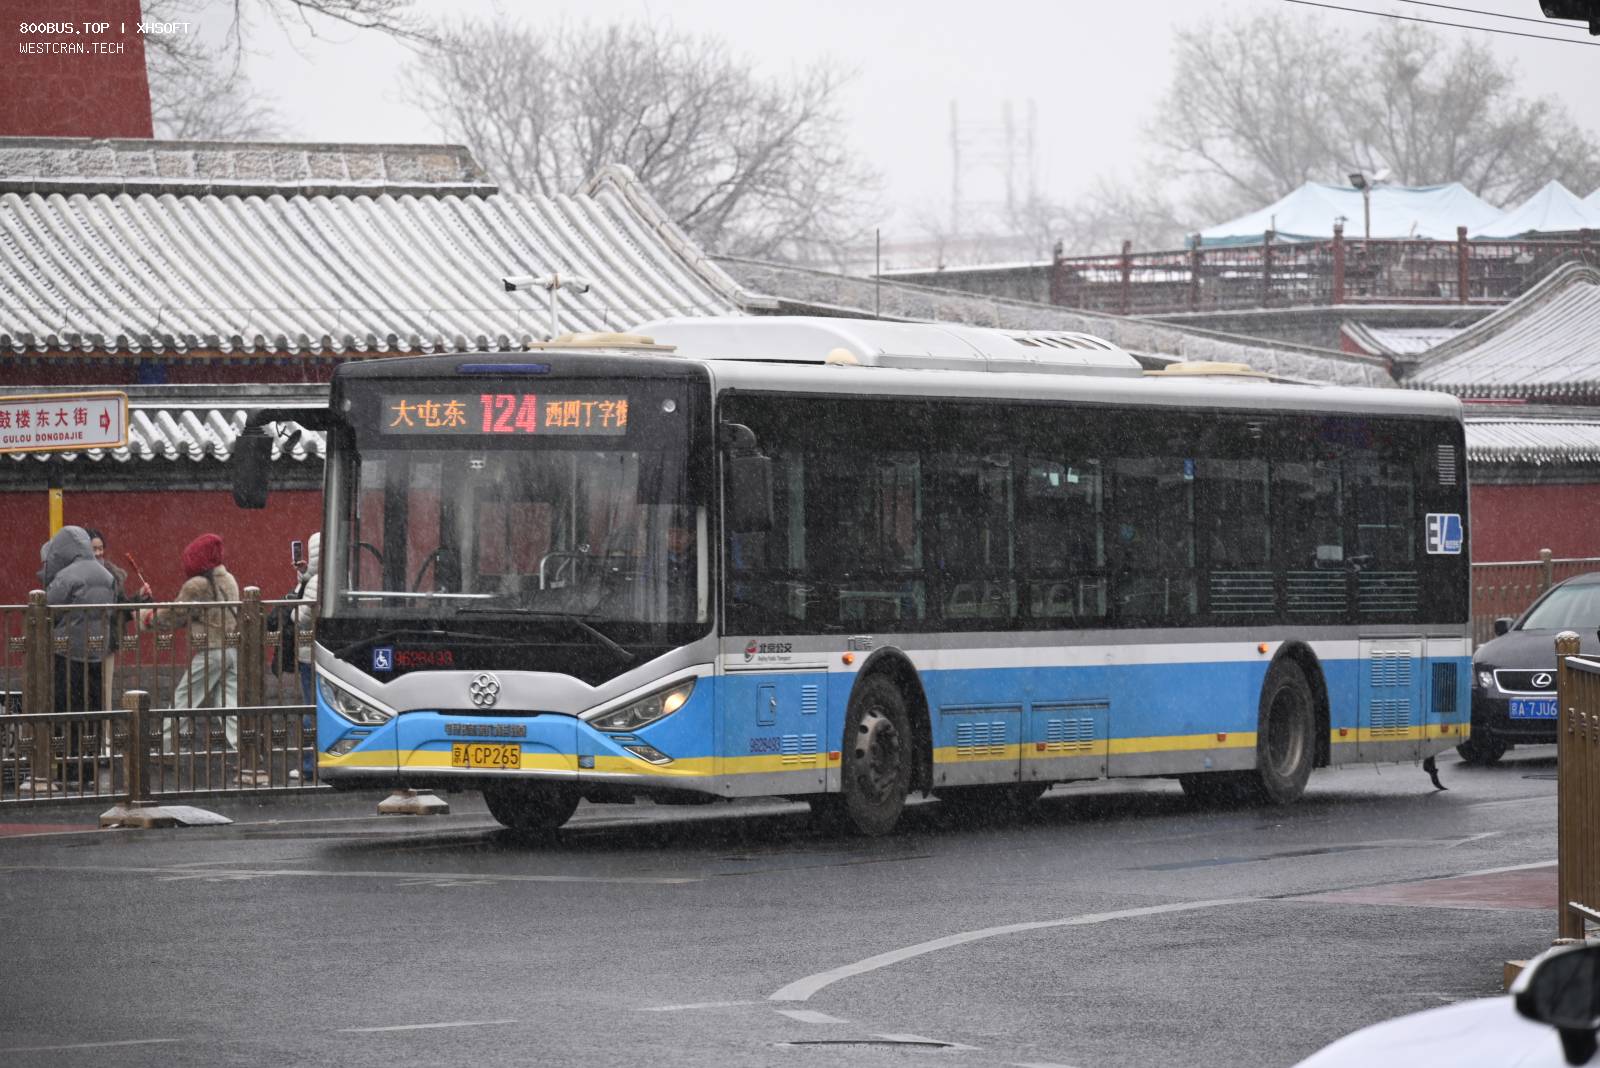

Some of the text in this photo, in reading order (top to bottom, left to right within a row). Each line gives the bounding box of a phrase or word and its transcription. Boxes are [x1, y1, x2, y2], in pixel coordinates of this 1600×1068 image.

[390, 399, 467, 428] 大屯东
[480, 394, 537, 433] 124
[3, 431, 83, 444] GULOU DONGDAJIE
[759, 642, 793, 654] 北京公交
